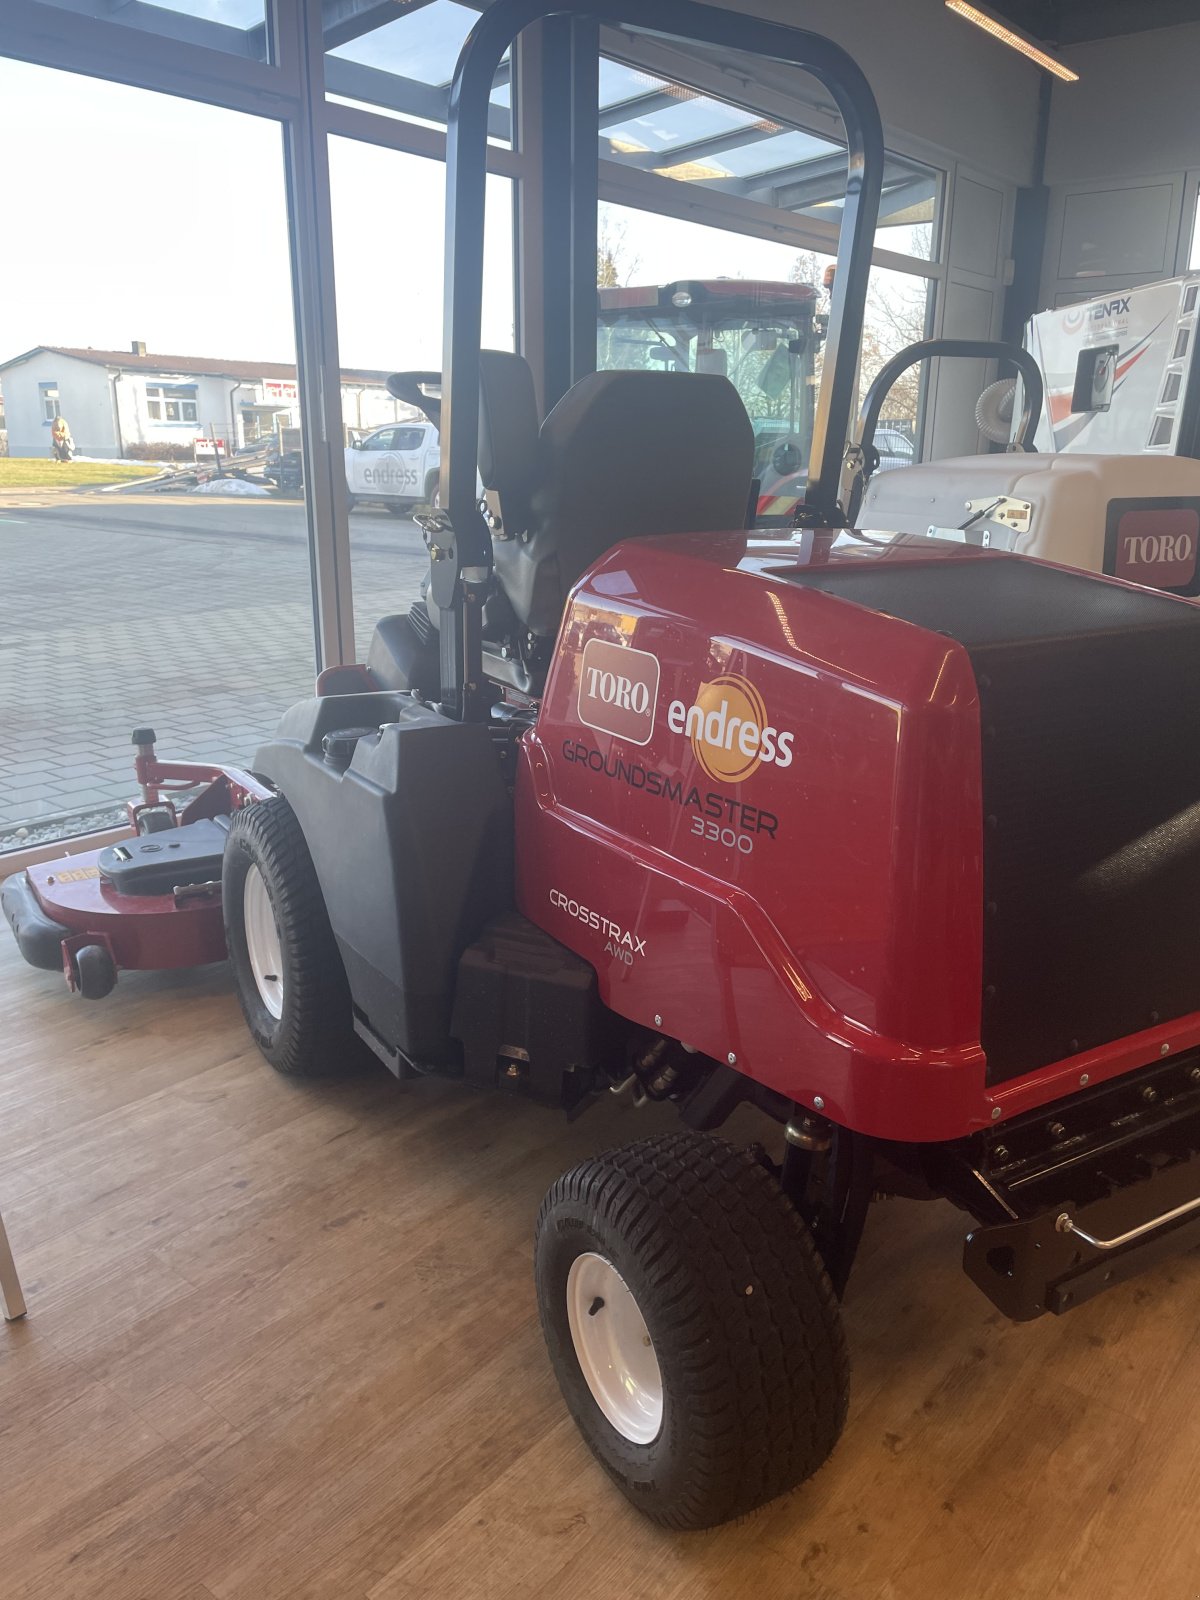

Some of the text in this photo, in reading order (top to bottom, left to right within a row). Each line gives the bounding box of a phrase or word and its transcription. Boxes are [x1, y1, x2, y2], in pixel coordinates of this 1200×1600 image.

[1087, 297, 1131, 321] TENAX
[364, 461, 418, 485] endress
[1124, 534, 1192, 564] TORO
[587, 667, 649, 714] TORO
[668, 700, 795, 768] endress
[562, 740, 779, 840] GROUNDSMASTER
[690, 815, 753, 854] 3300
[549, 888, 647, 957] CROSSTRAX
[603, 941, 634, 966] AWD
